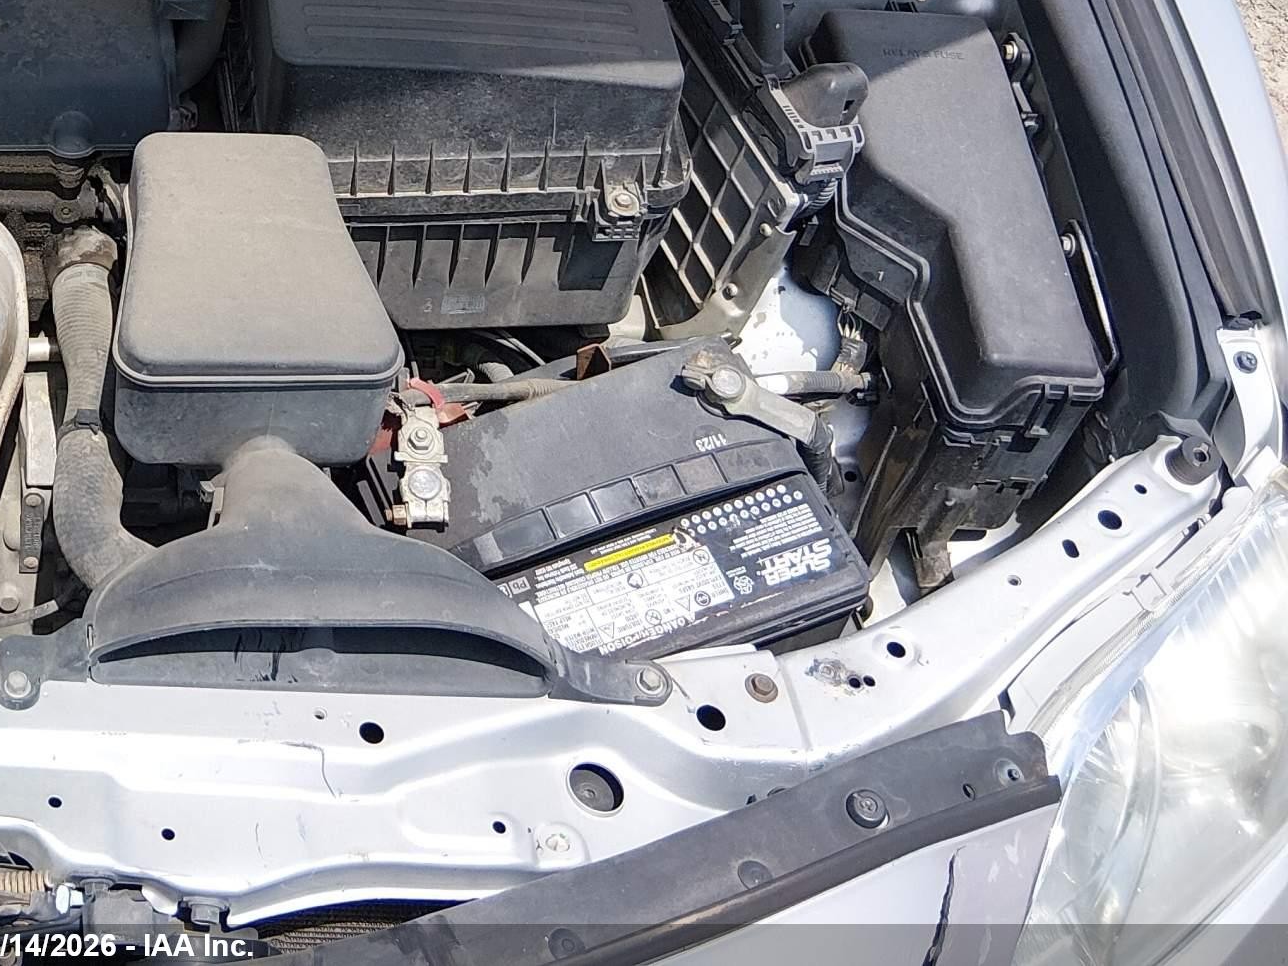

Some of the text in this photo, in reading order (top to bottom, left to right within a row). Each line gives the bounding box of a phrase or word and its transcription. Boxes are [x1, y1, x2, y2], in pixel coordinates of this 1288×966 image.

[695, 433, 727, 453] 11/23
[759, 538, 832, 575] START
[765, 555, 831, 586] SUPER
[512, 580, 527, 593] Pb
